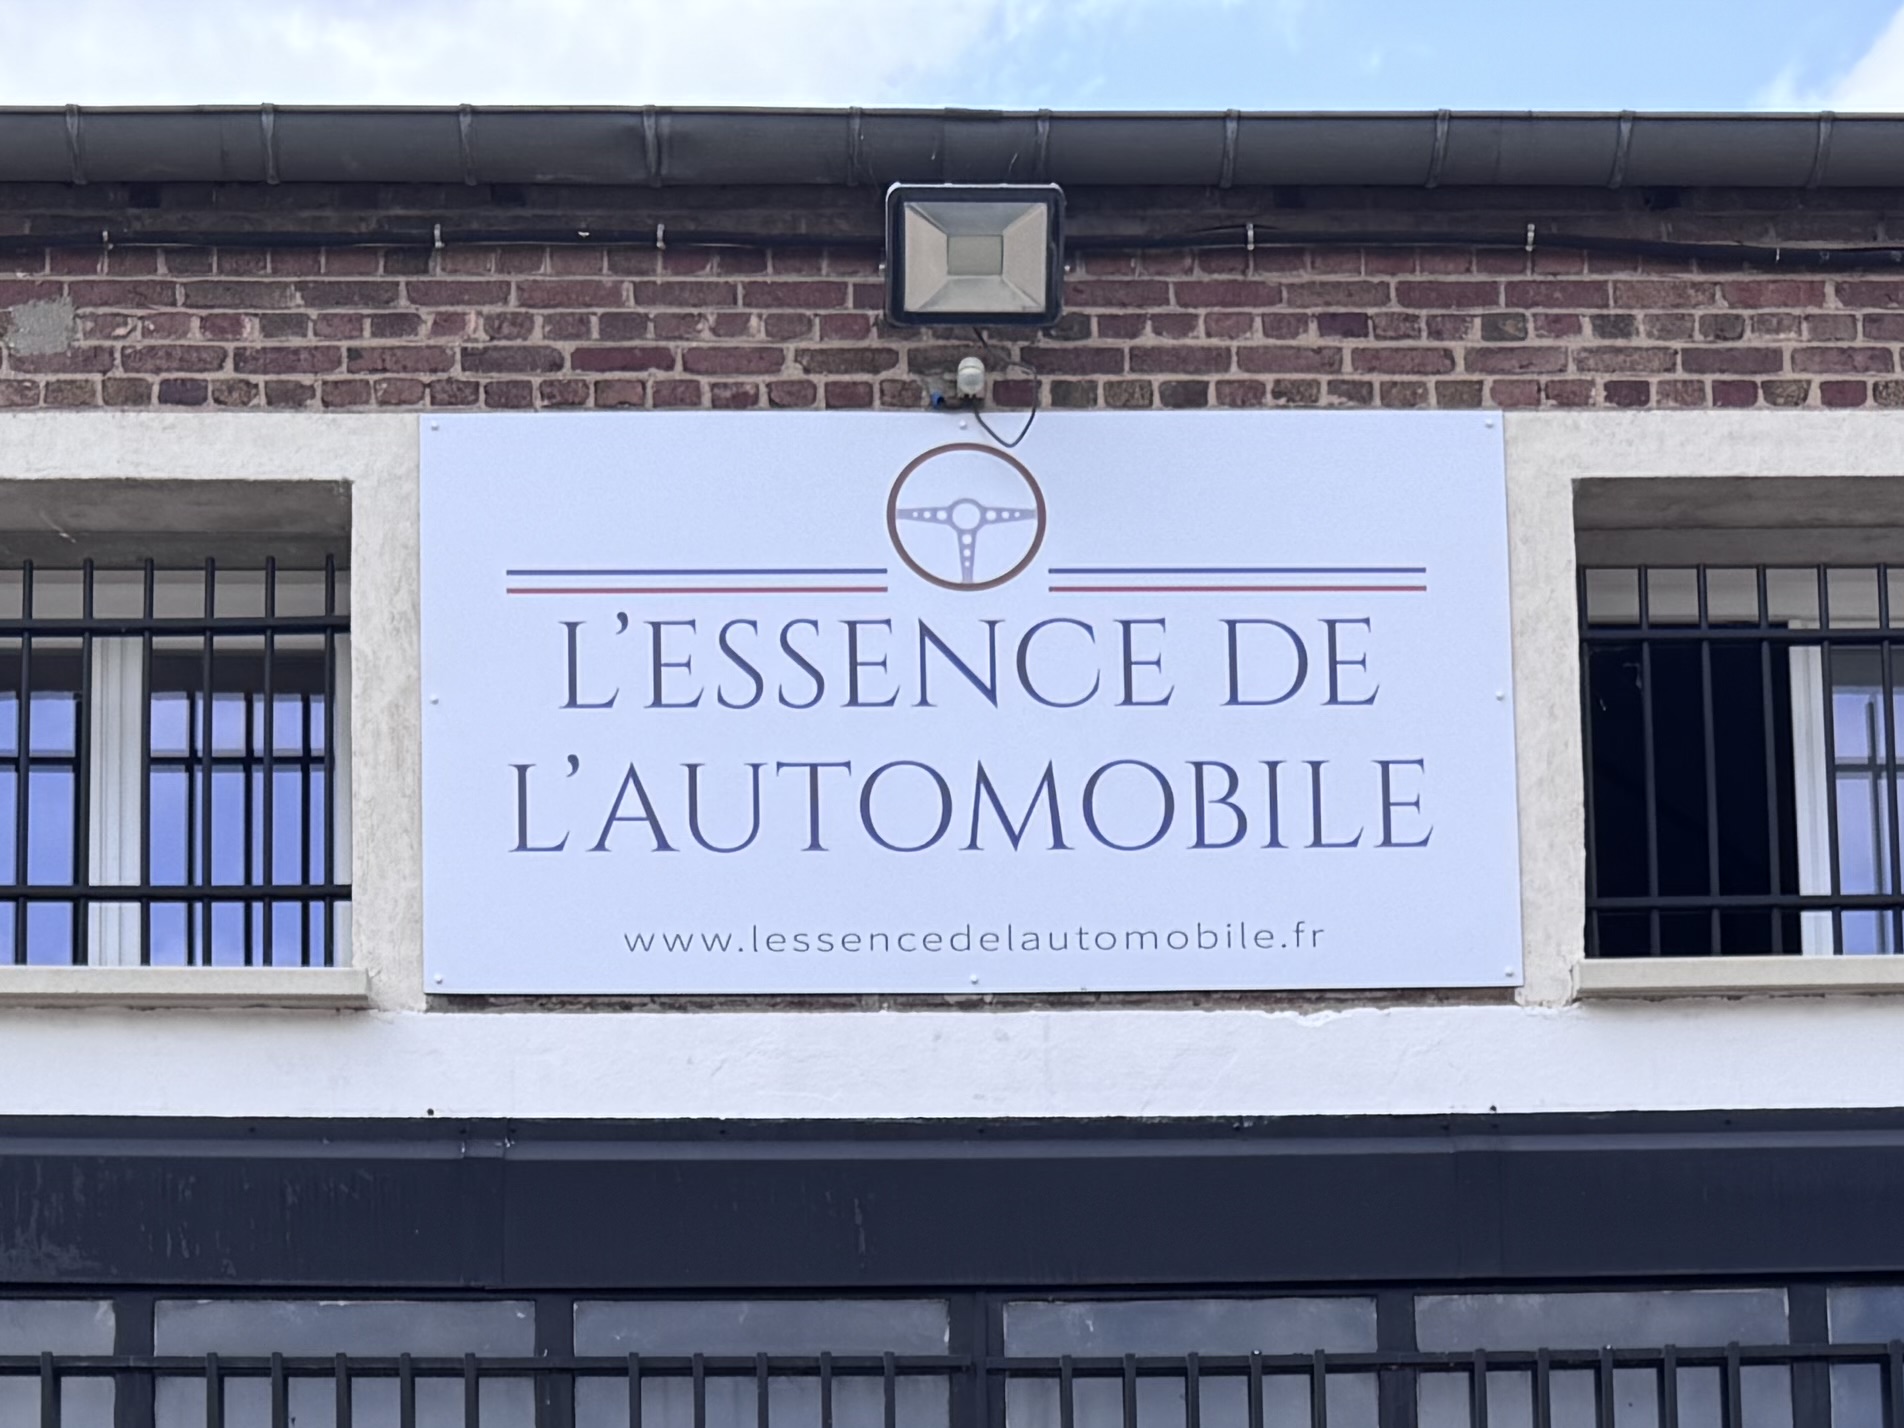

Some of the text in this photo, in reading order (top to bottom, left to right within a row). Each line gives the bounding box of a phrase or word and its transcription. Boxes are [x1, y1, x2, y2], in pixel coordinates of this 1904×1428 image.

[559, 611, 1380, 710] L'ESSENCE DE
[509, 753, 1434, 854] L'AUTOMOBILE
[623, 920, 1326, 953] www.lessencedelautomobile.fr
